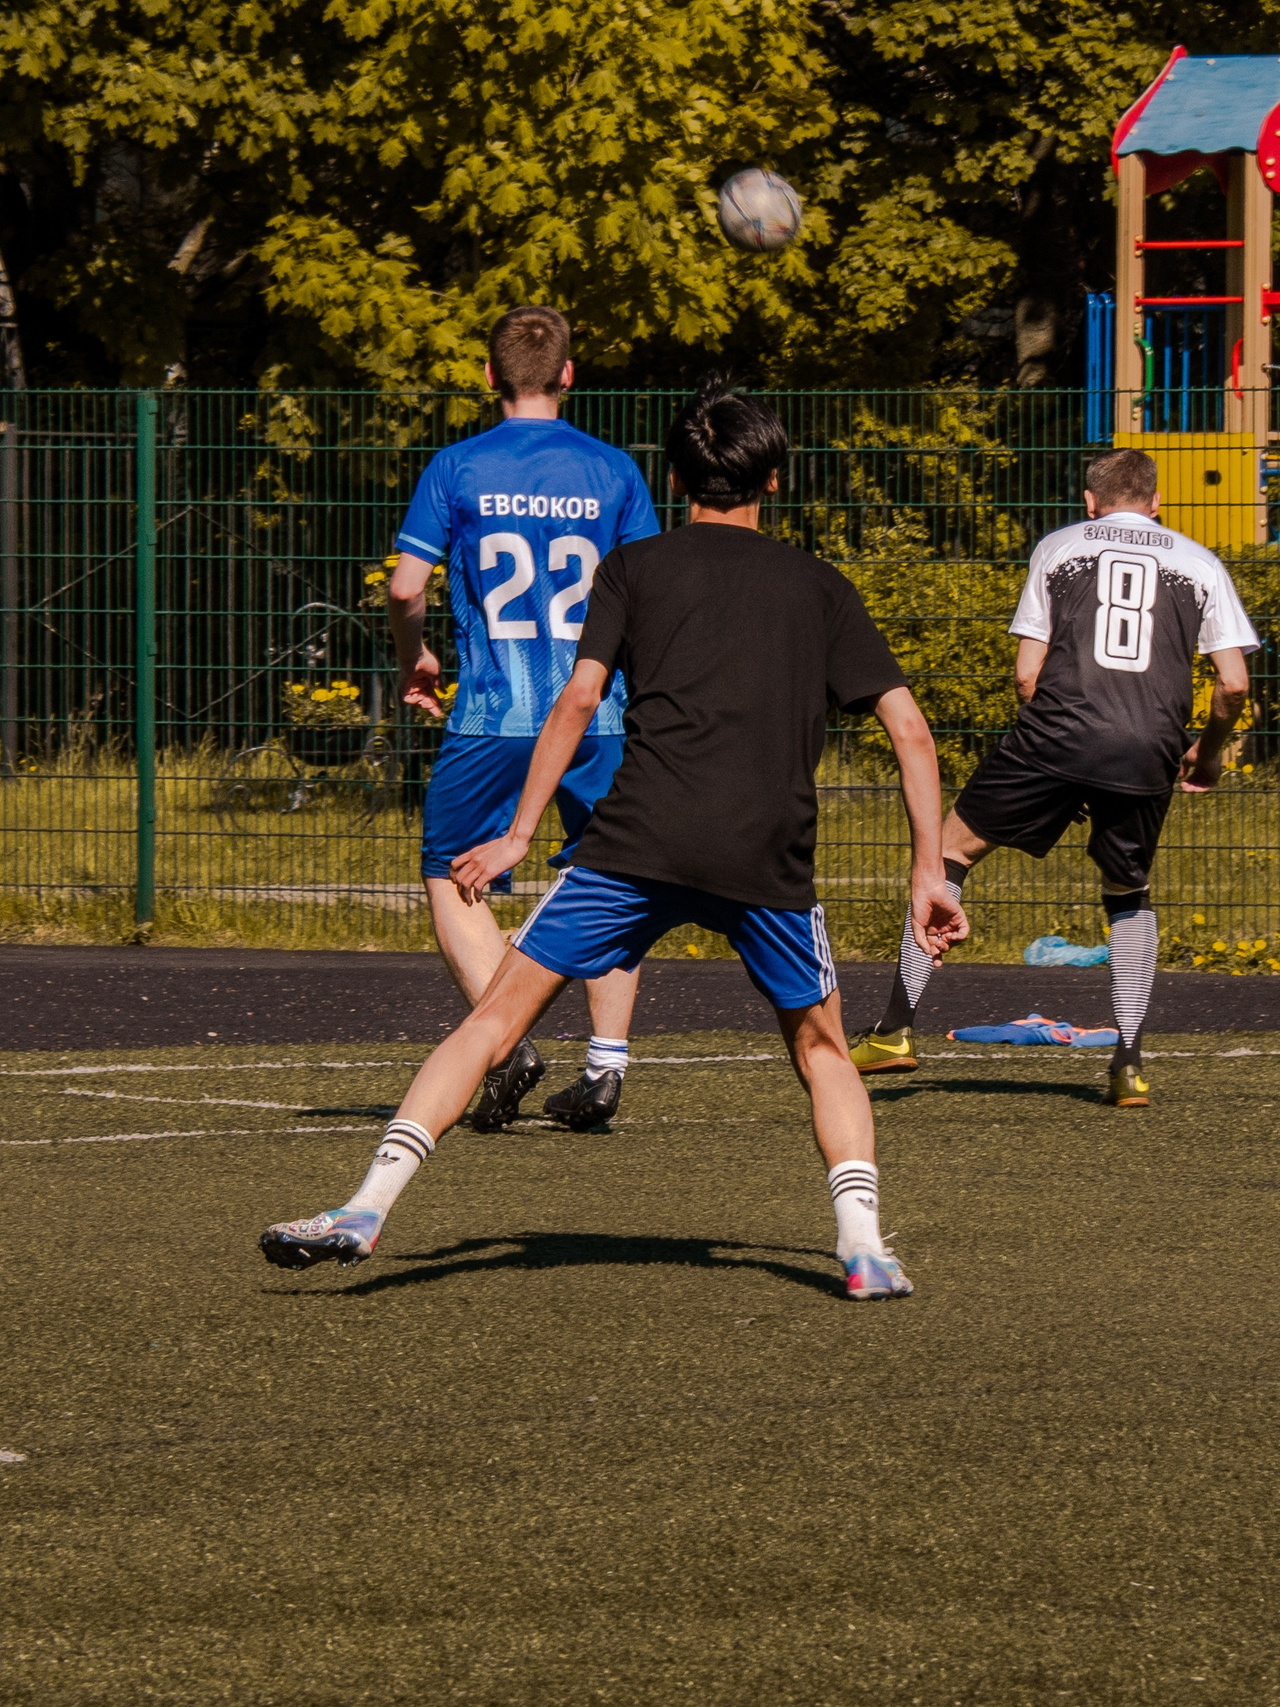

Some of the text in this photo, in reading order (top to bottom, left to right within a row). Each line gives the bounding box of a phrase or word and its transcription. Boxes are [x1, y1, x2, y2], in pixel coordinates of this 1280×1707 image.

[479, 493, 601, 520] ЕВСЮКОВ
[1084, 524, 1174, 550] ЗАРЕМБО
[479, 531, 601, 641] 22
[1094, 549, 1159, 673] 8
